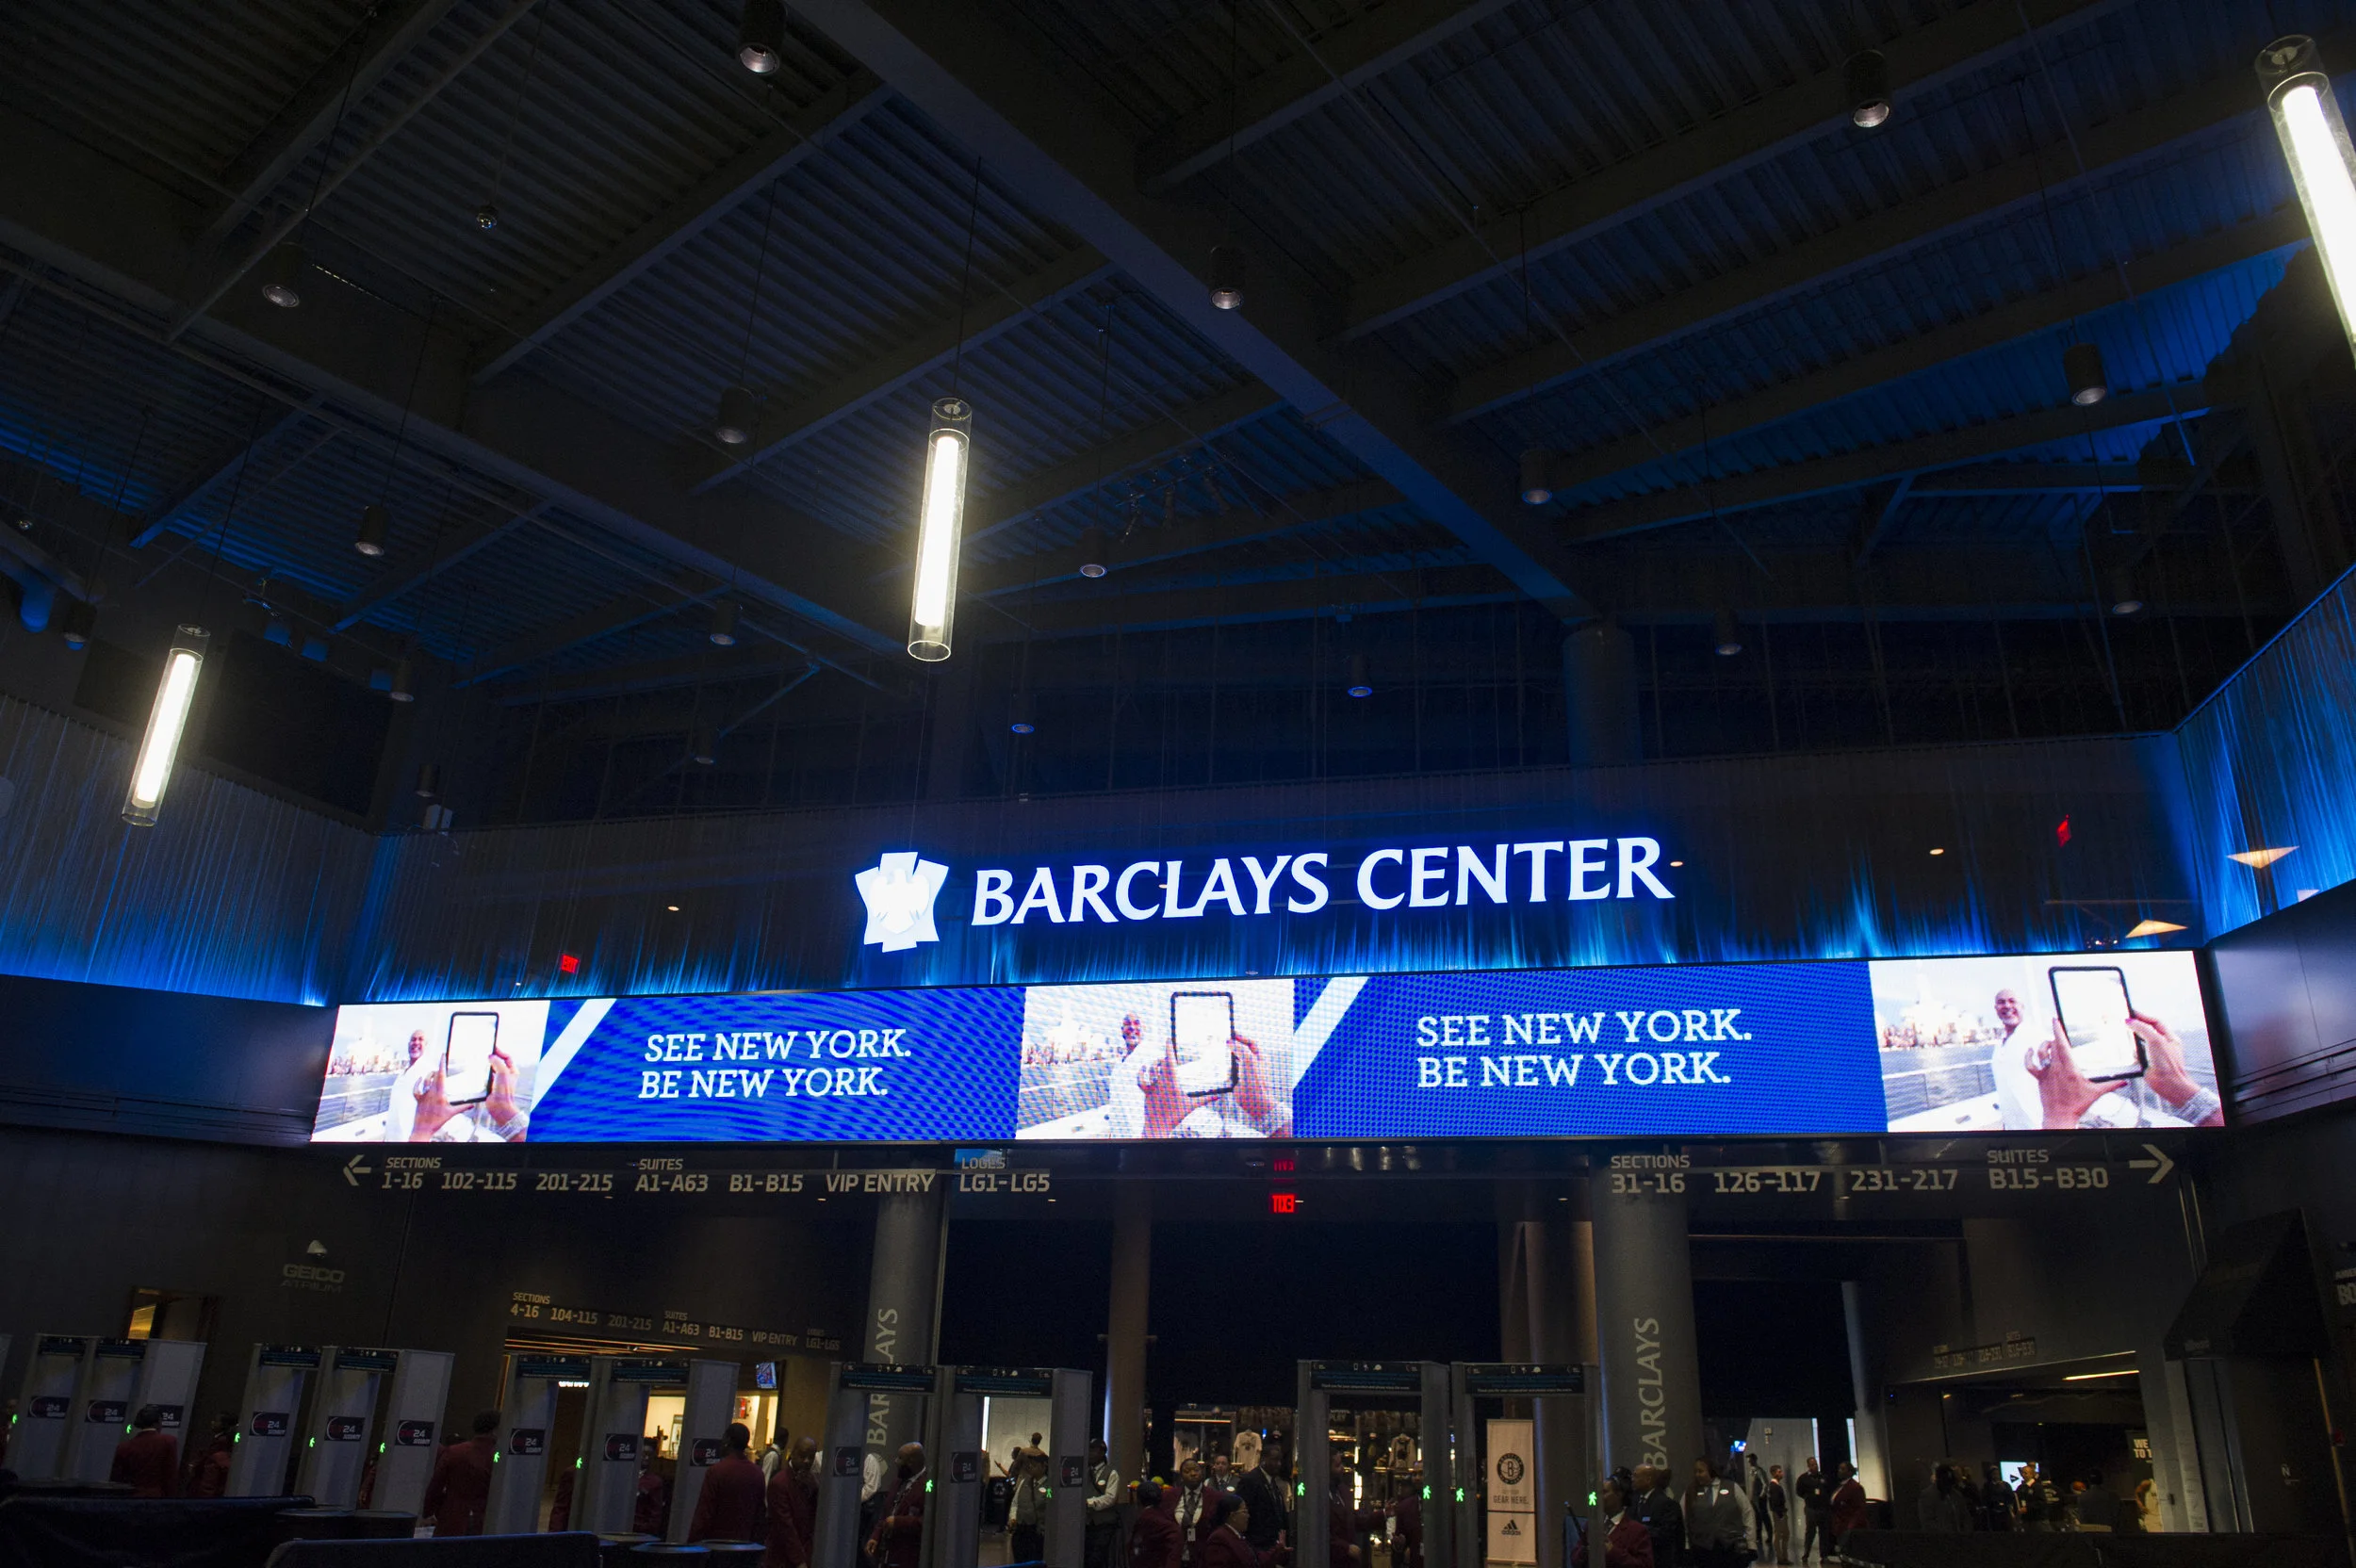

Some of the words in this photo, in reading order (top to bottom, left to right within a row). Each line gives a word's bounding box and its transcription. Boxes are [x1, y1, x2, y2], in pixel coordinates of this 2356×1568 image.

[971, 852, 1330, 926] BARCLAYS
[1357, 836, 1676, 910] CENTER
[1416, 1015, 1491, 1047] SEE
[1502, 1012, 1605, 1045] NEW
[1615, 1008, 1752, 1042] YORK.
[645, 1034, 706, 1062] SEE
[712, 1031, 798, 1061] NEW
[806, 1029, 911, 1058] YORK.
[1417, 1056, 1468, 1087] BE
[1480, 1054, 1583, 1086] NEW
[1594, 1052, 1731, 1085] YORK.
[638, 1070, 683, 1099] BE
[688, 1069, 775, 1098] NEW
[781, 1067, 889, 1097] YORK.
[385, 1156, 442, 1168] SECTIONS
[639, 1158, 683, 1170] SUITES
[1611, 1155, 1691, 1169] SECTIONS
[1988, 1149, 2049, 1164] SUITES
[381, 1172, 423, 1189] 1-16
[441, 1172, 517, 1190] 102-115
[535, 1173, 614, 1192] 201-215
[635, 1174, 709, 1192] A1-A63
[729, 1174, 804, 1192] B1-B15
[826, 1174, 859, 1192] VIP
[863, 1174, 936, 1192] ENTRY
[959, 1173, 1051, 1192] LG1-LG5
[1612, 1173, 1685, 1194] 31-16
[1713, 1170, 1821, 1193] 126-117
[1851, 1169, 1959, 1191] 231-217
[1988, 1168, 2109, 1189] B15-B30
[284, 1263, 346, 1283] GEICO
[513, 1292, 550, 1305] SECTIONS
[510, 1304, 540, 1318] 4-16
[550, 1307, 598, 1325] 104-115
[607, 1315, 652, 1331] 201-215
[663, 1310, 688, 1321] SUITES
[662, 1321, 700, 1336] A1-A63
[709, 1326, 744, 1341] B1-B15
[752, 1331, 767, 1343] VIP
[769, 1331, 799, 1347] ENTRY
[1634, 1317, 1668, 1471] BARCLAYS
[268, 1420, 280, 1429] 24
[343, 1425, 356, 1433] 24
[413, 1429, 426, 1438] 24
[525, 1437, 537, 1446] 24
